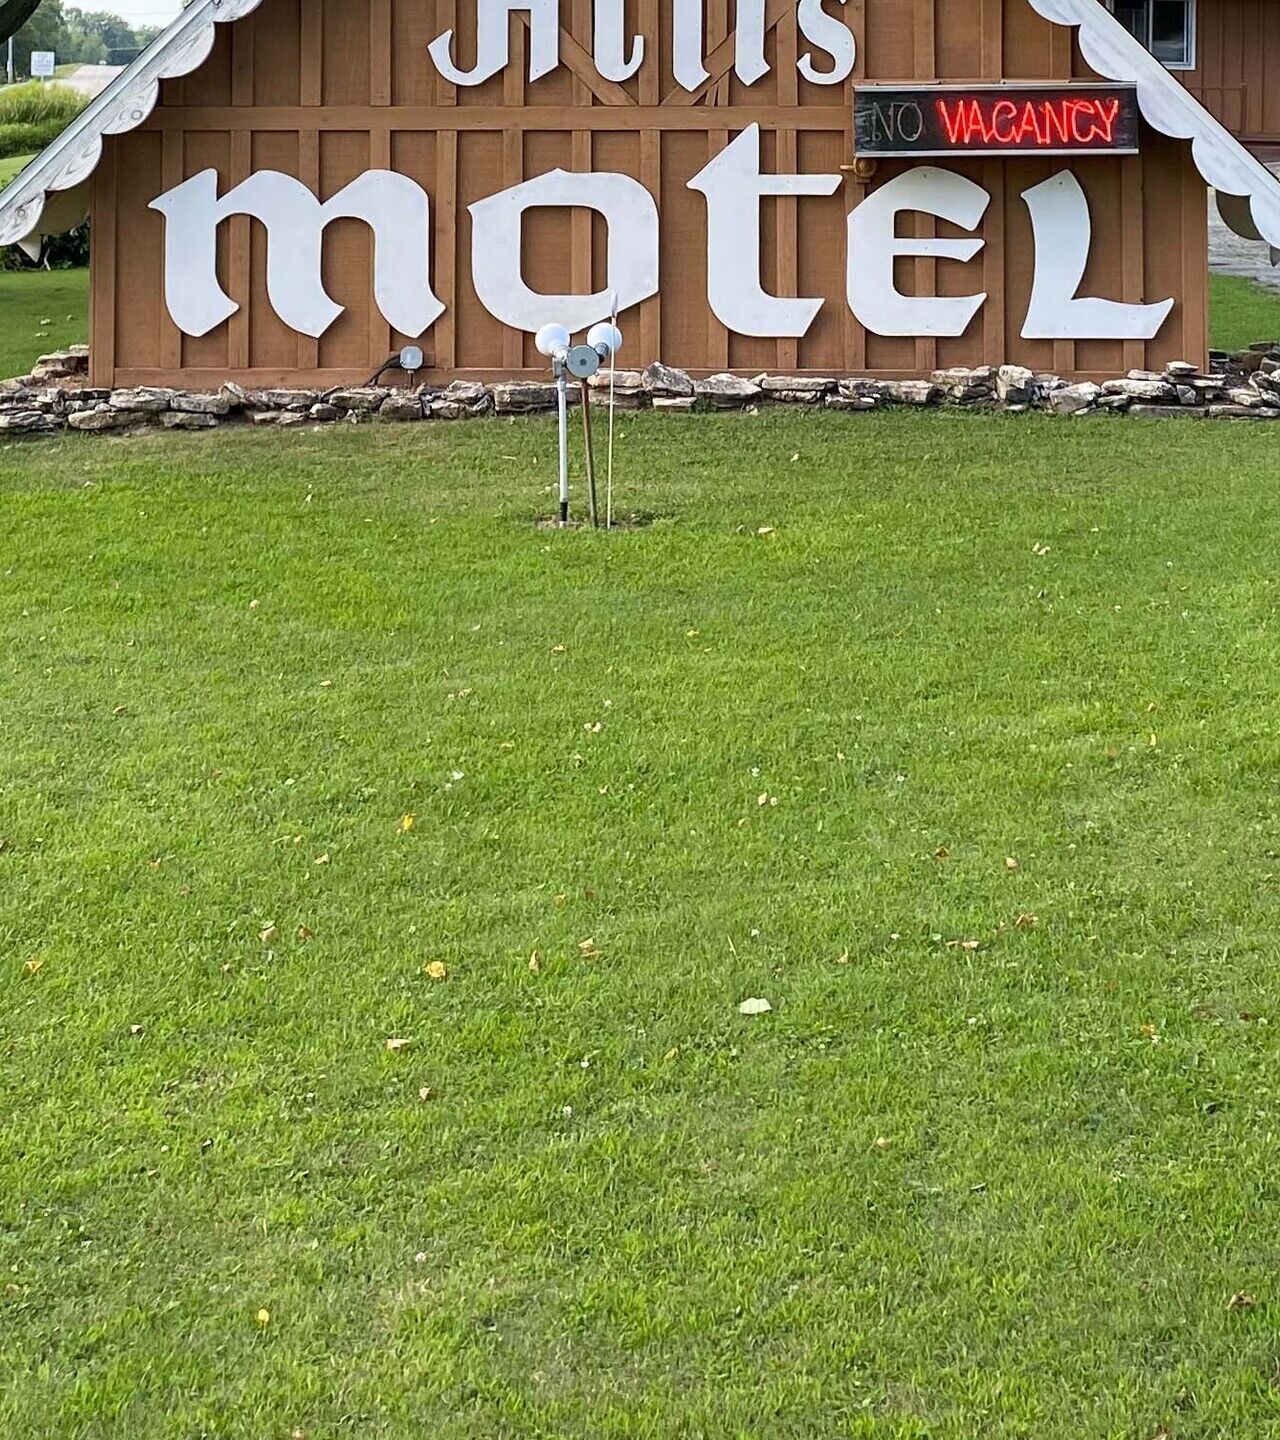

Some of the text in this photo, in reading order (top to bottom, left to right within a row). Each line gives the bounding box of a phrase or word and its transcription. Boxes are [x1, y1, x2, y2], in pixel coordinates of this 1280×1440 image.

[871, 99, 1119, 144] NO VACANCY
[149, 123, 1175, 339] motel
